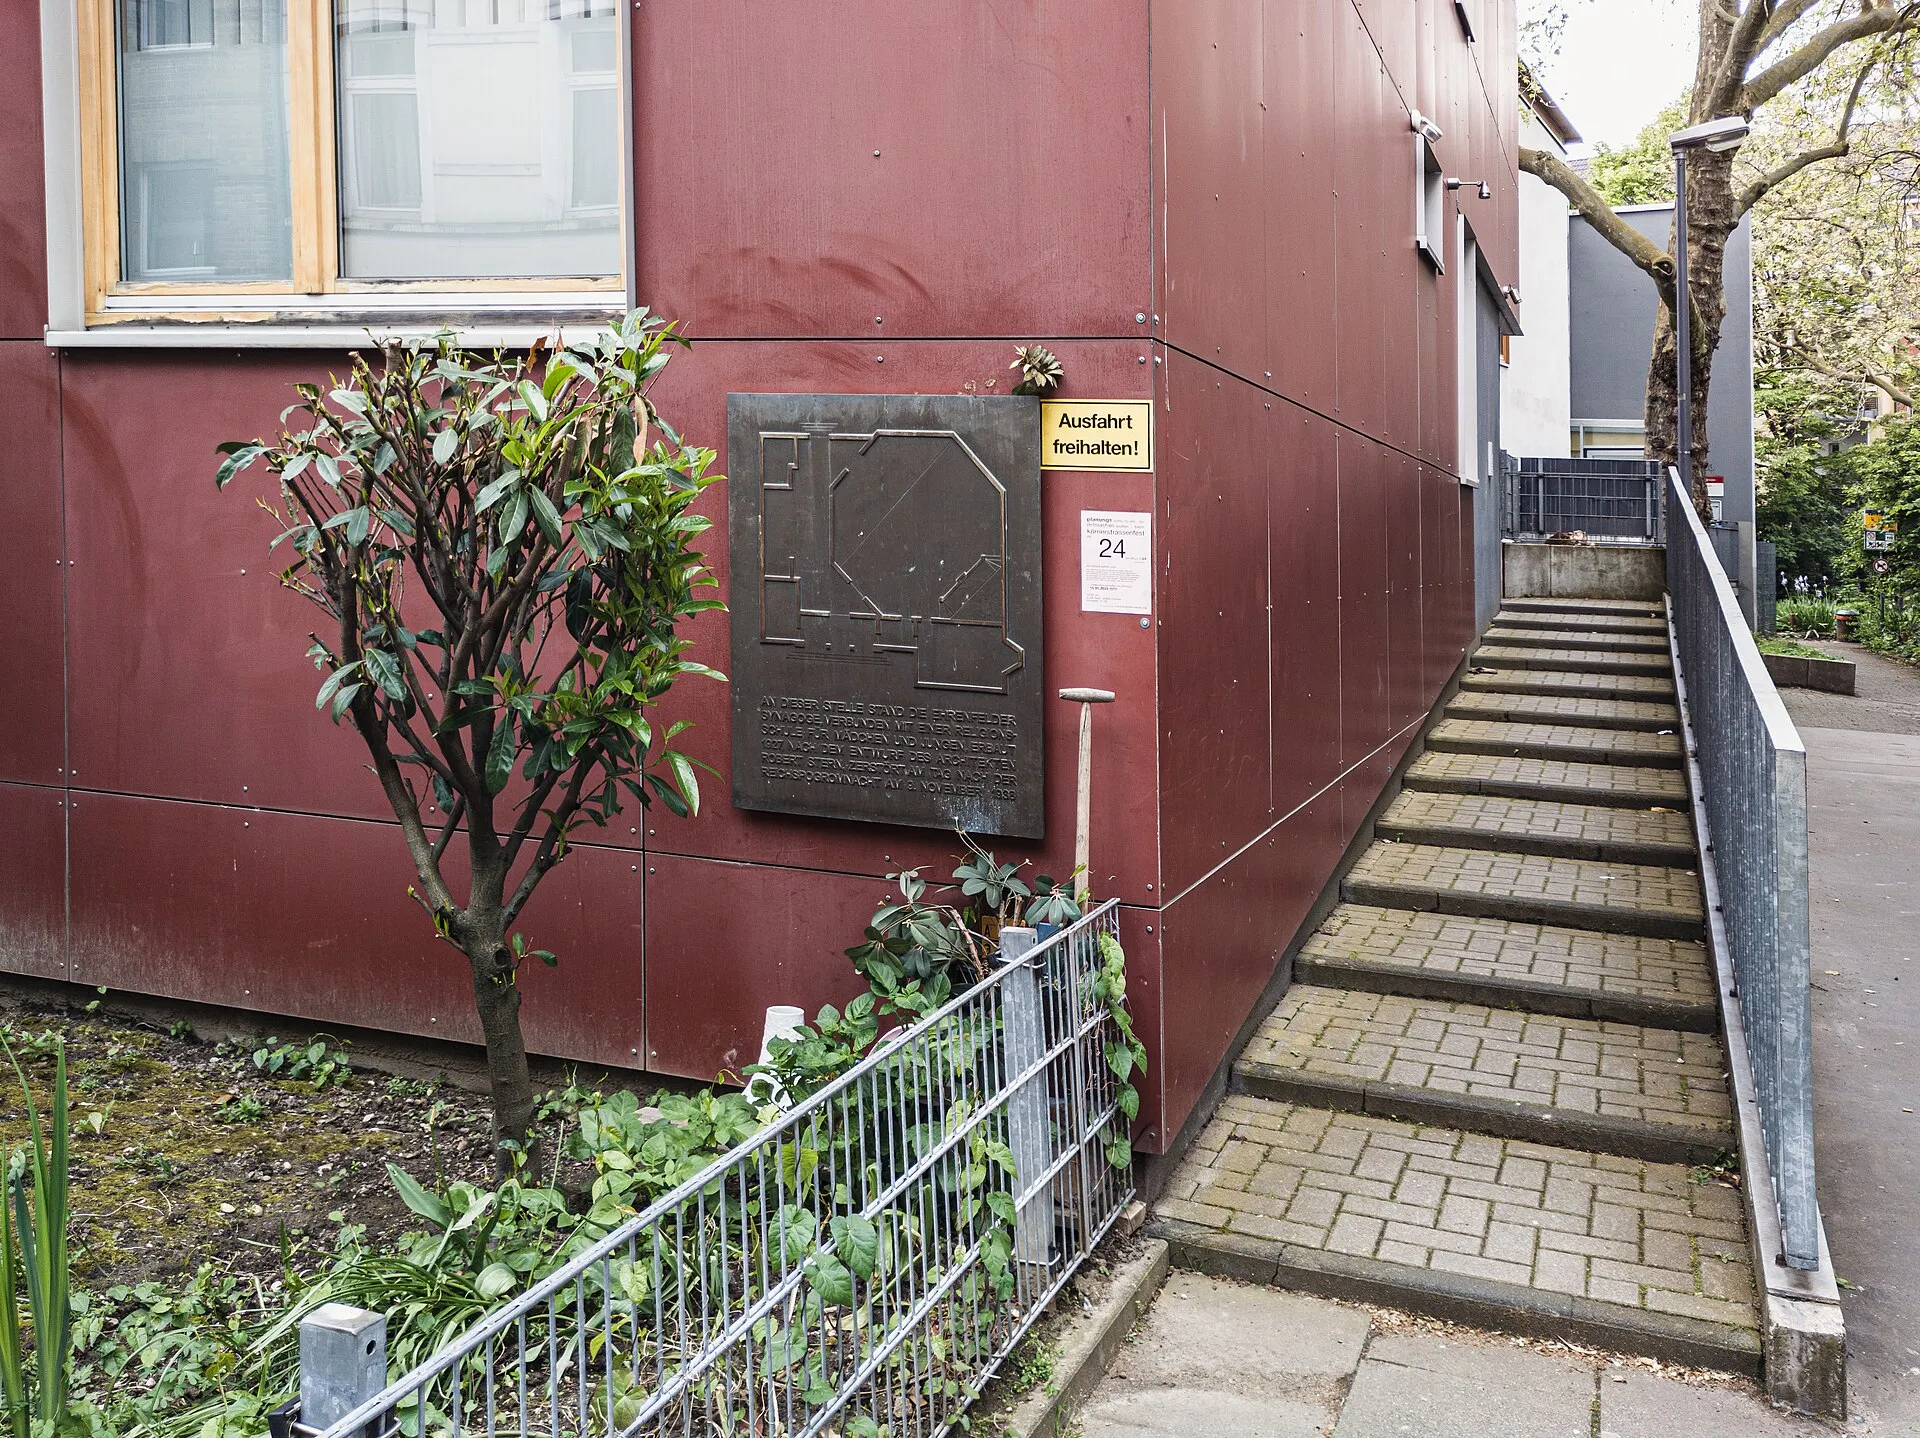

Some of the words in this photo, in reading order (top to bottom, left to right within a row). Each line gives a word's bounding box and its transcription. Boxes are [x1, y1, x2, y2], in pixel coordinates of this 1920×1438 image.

[1058, 412, 1133, 430] Ausfahrt
[1052, 438, 1139, 456] freihalten!
[1099, 538, 1126, 559] 24
[761, 696, 776, 707] AN
[780, 697, 820, 711] DIESER
[822, 700, 864, 714] STELLE
[868, 703, 905, 717] STAND
[909, 706, 927, 719] DIE
[932, 708, 1017, 726] EHRENFELDER
[823, 714, 890, 730] VERBUNDEN
[894, 720, 913, 732] MIT
[918, 722, 952, 736] EINER
[761, 723, 804, 738] SCHULE
[807, 726, 830, 740] FÜR
[834, 729, 889, 745] MÄDCHEN
[893, 735, 917, 748] UND
[970, 741, 1017, 755] ERBAUT
[761, 738, 784, 749] 1927
[787, 739, 816, 752] NACH
[820, 742, 844, 755] DEM
[849, 745, 905, 760] ENTWURF
[908, 750, 931, 763] DES
[935, 753, 1017, 771] ARCHITEKTEN
[761, 751, 804, 766] ROBERT
[929, 766, 951, 780] TAG
[957, 768, 988, 782] NACH
[993, 771, 1018, 787] DER
[761, 766, 882, 788] REICHSPOGROMNACHT
[884, 777, 902, 790] AM
[920, 780, 983, 798] NOVEMBER
